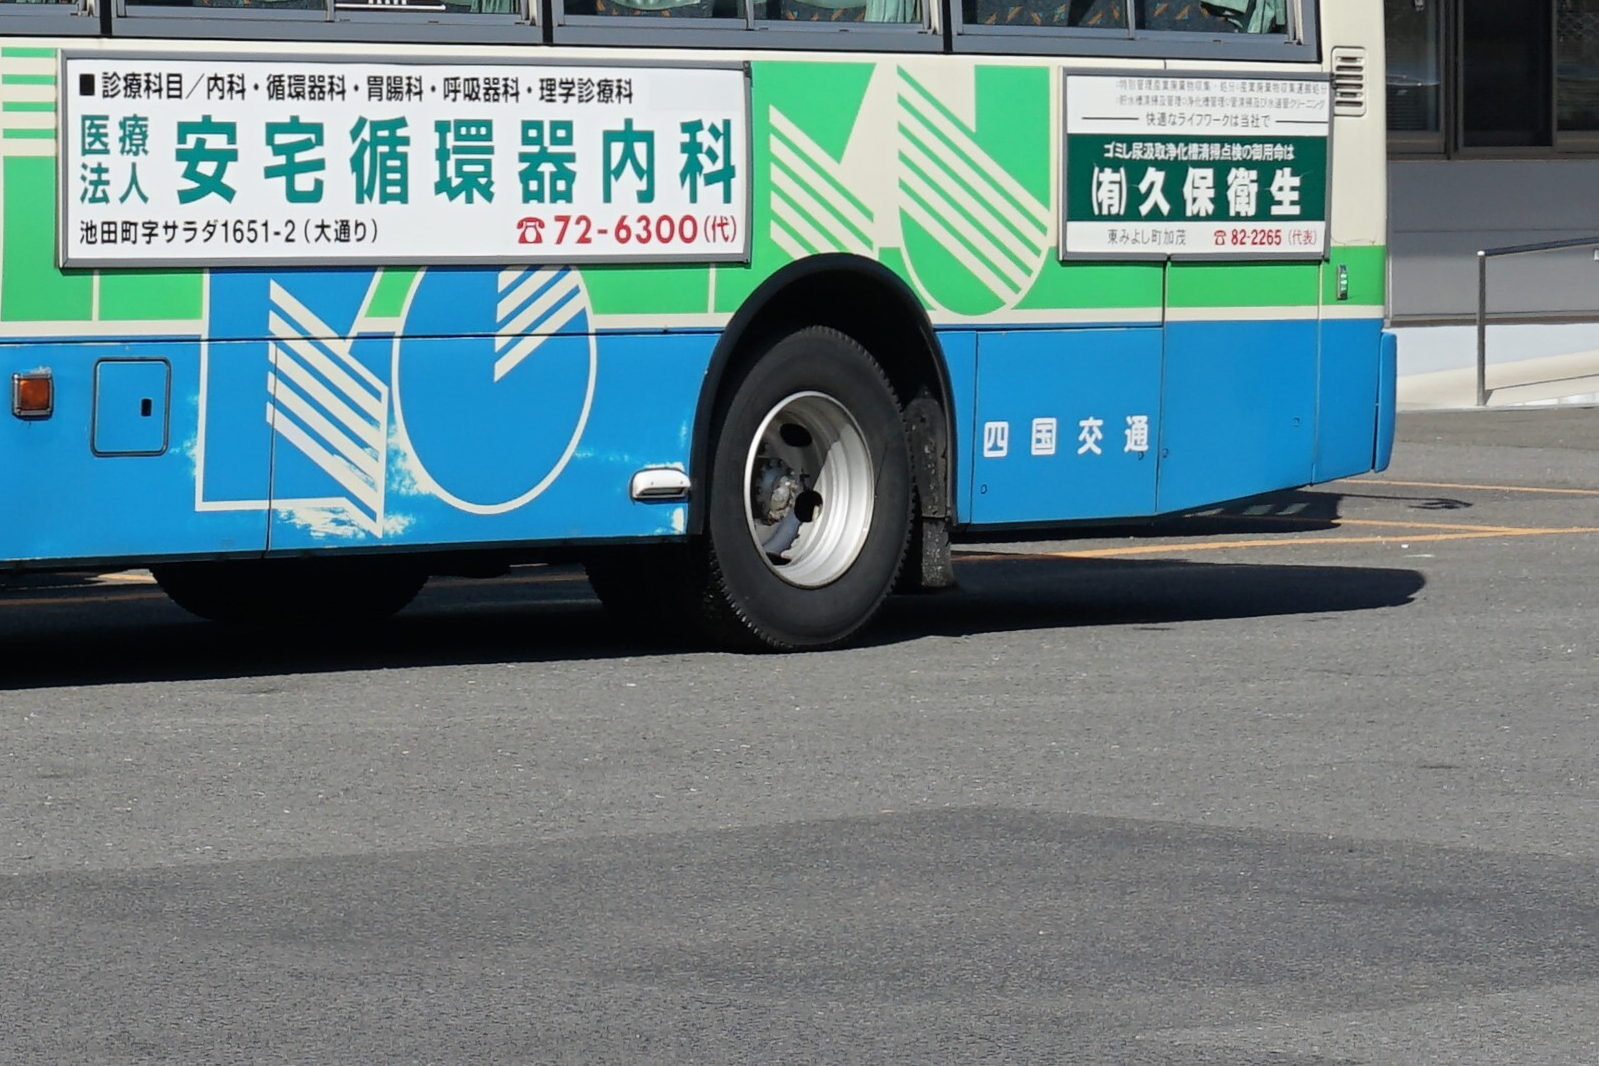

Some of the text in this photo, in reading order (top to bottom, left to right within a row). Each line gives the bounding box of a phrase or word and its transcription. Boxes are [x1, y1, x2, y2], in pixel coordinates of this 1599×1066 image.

[80, 113, 149, 157] 医療
[1145, 112, 1270, 128] 快適なライフワークは当社で
[175, 114, 736, 205] 安宅循環器内科
[79, 162, 149, 205] 法人
[1107, 228, 1187, 246] 東みよし町加茂
[983, 415, 1149, 458] 四国交通
